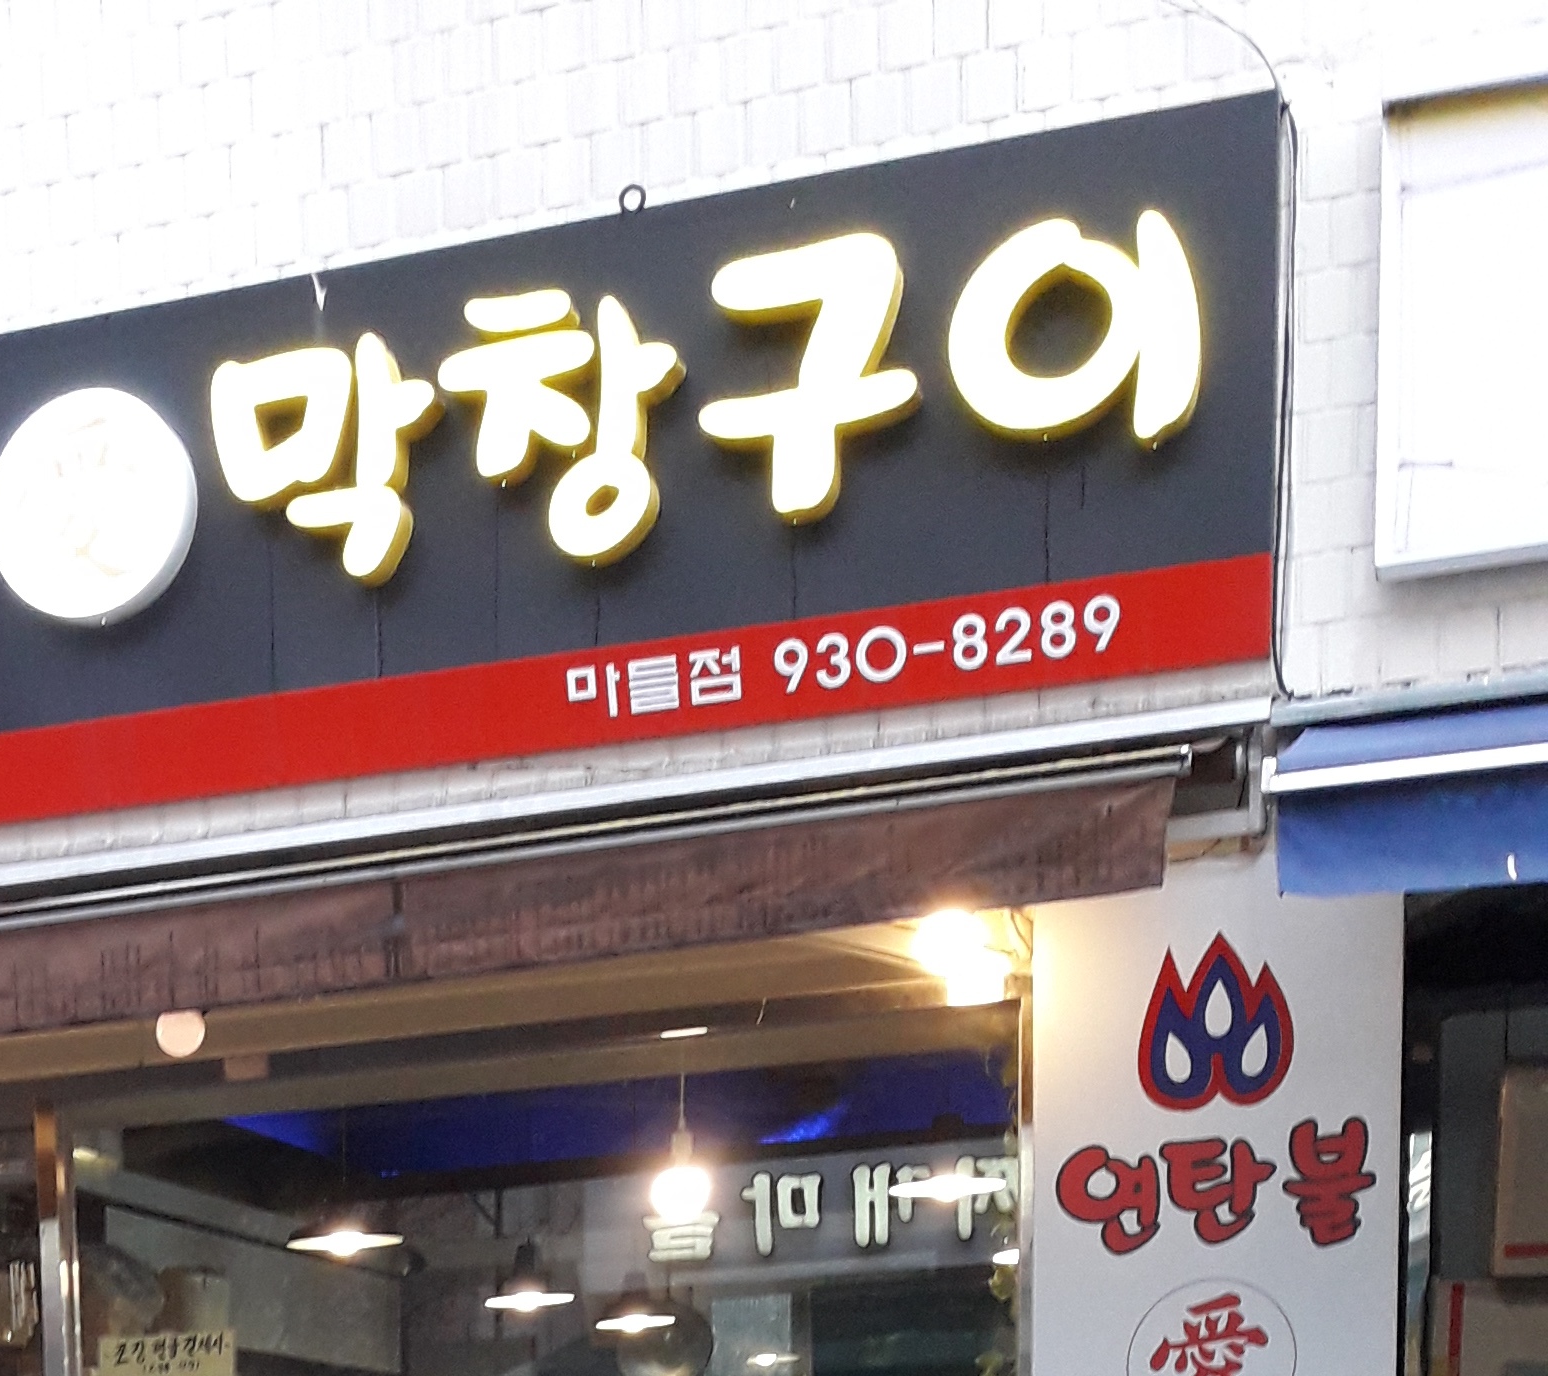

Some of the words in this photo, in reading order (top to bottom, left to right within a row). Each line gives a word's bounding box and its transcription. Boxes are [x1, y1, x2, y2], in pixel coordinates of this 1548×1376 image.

[209, 207, 1204, 587] 막창구이
[565, 642, 745, 720] 마들점
[771, 593, 1123, 697] 930-8289
[1055, 1116, 1378, 1257] 연탄불
